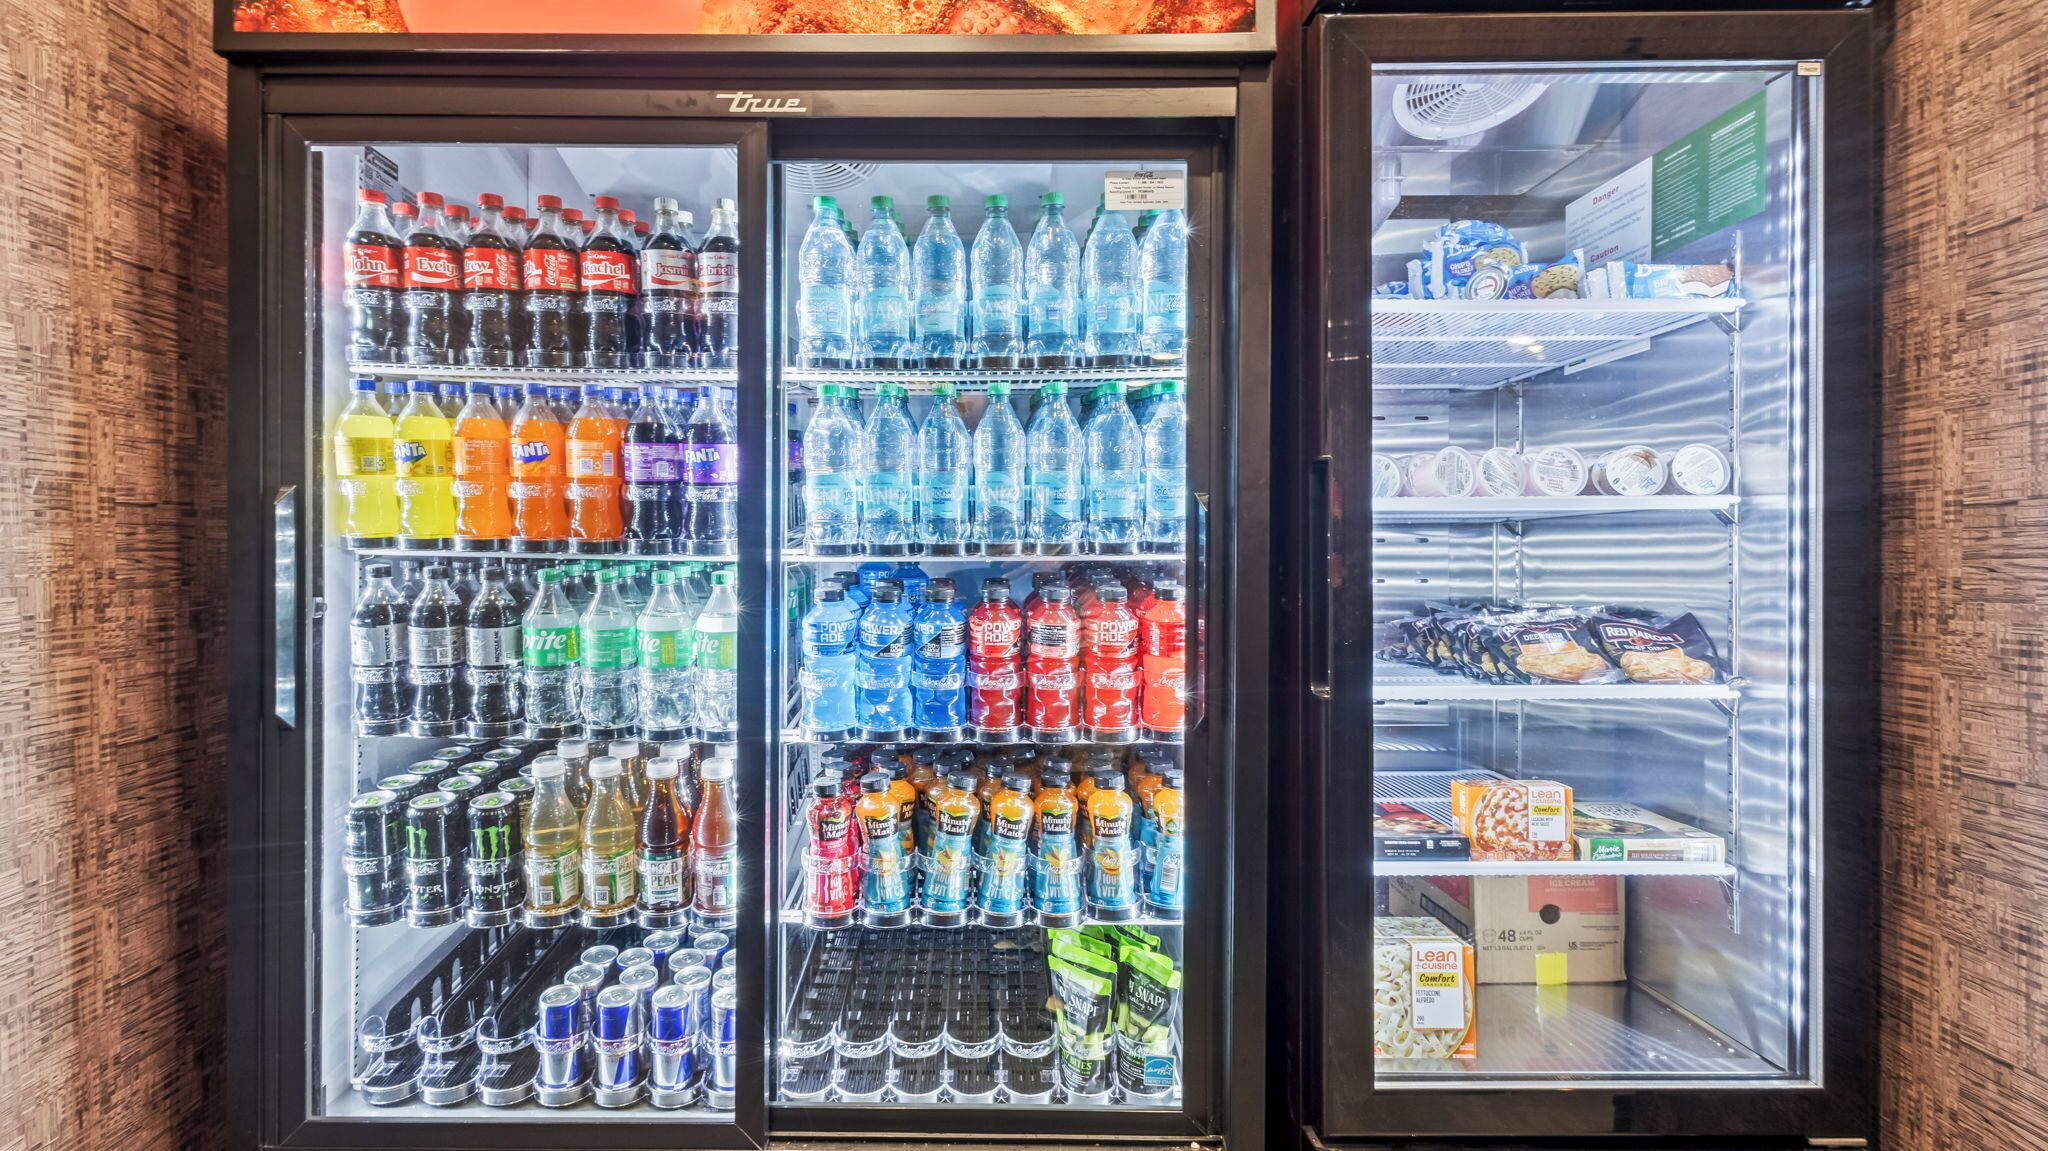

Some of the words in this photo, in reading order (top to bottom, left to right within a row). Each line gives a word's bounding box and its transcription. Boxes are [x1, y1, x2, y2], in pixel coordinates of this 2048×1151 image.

[1592, 185, 1620, 206] Danger
[1590, 244, 1619, 264] Caution
[351, 256, 386, 272] John
[584, 262, 625, 276] Rachel
[513, 441, 551, 458] FANTA
[686, 447, 721, 463] FANTA
[820, 633, 845, 643] ADE
[984, 631, 1009, 643] ADE
[1100, 631, 1124, 643] ADE
[1605, 626, 1628, 637] RED
[1628, 627, 1676, 643] BARON
[1531, 790, 1561, 799] Lean
[1593, 845, 1620, 854] Marie
[650, 874, 680, 887] PEAK
[1549, 879, 1564, 887] ICE
[1564, 879, 1596, 887] CREAM
[1498, 929, 1517, 943] 48
[1416, 950, 1457, 962] Lean
[1420, 963, 1458, 971] cuisine
[1419, 973, 1455, 983] Comfort
[1136, 984, 1167, 1010] SNAP!
